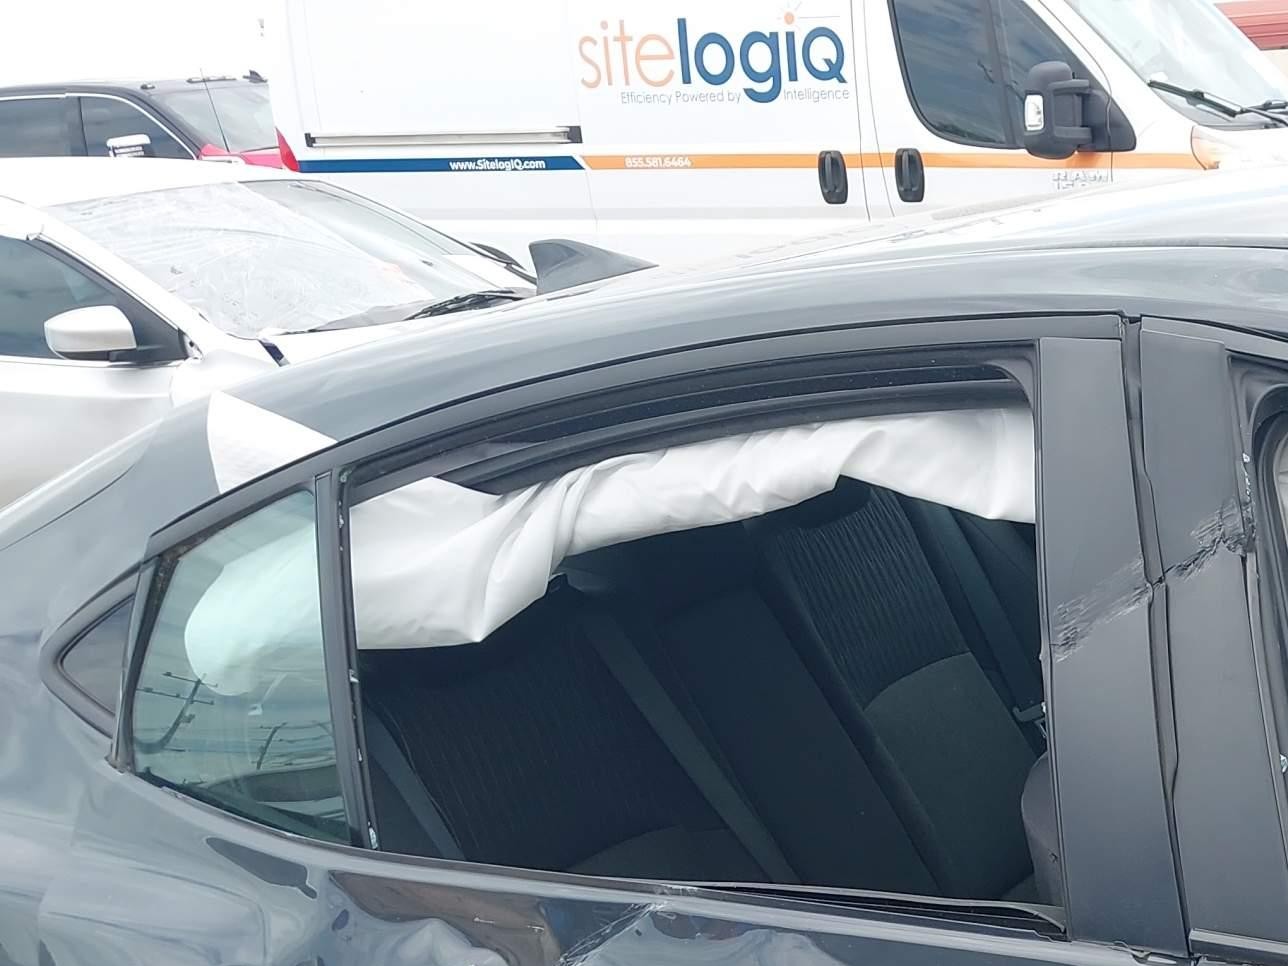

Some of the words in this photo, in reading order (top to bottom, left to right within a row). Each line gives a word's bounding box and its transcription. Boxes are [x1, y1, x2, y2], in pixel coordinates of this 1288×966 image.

[620, 91, 672, 105] Efficiency
[675, 90, 724, 104] Powered
[727, 89, 742, 103] by
[783, 88, 850, 103] Intelligence
[449, 158, 546, 171] www.SitelogIQ.com
